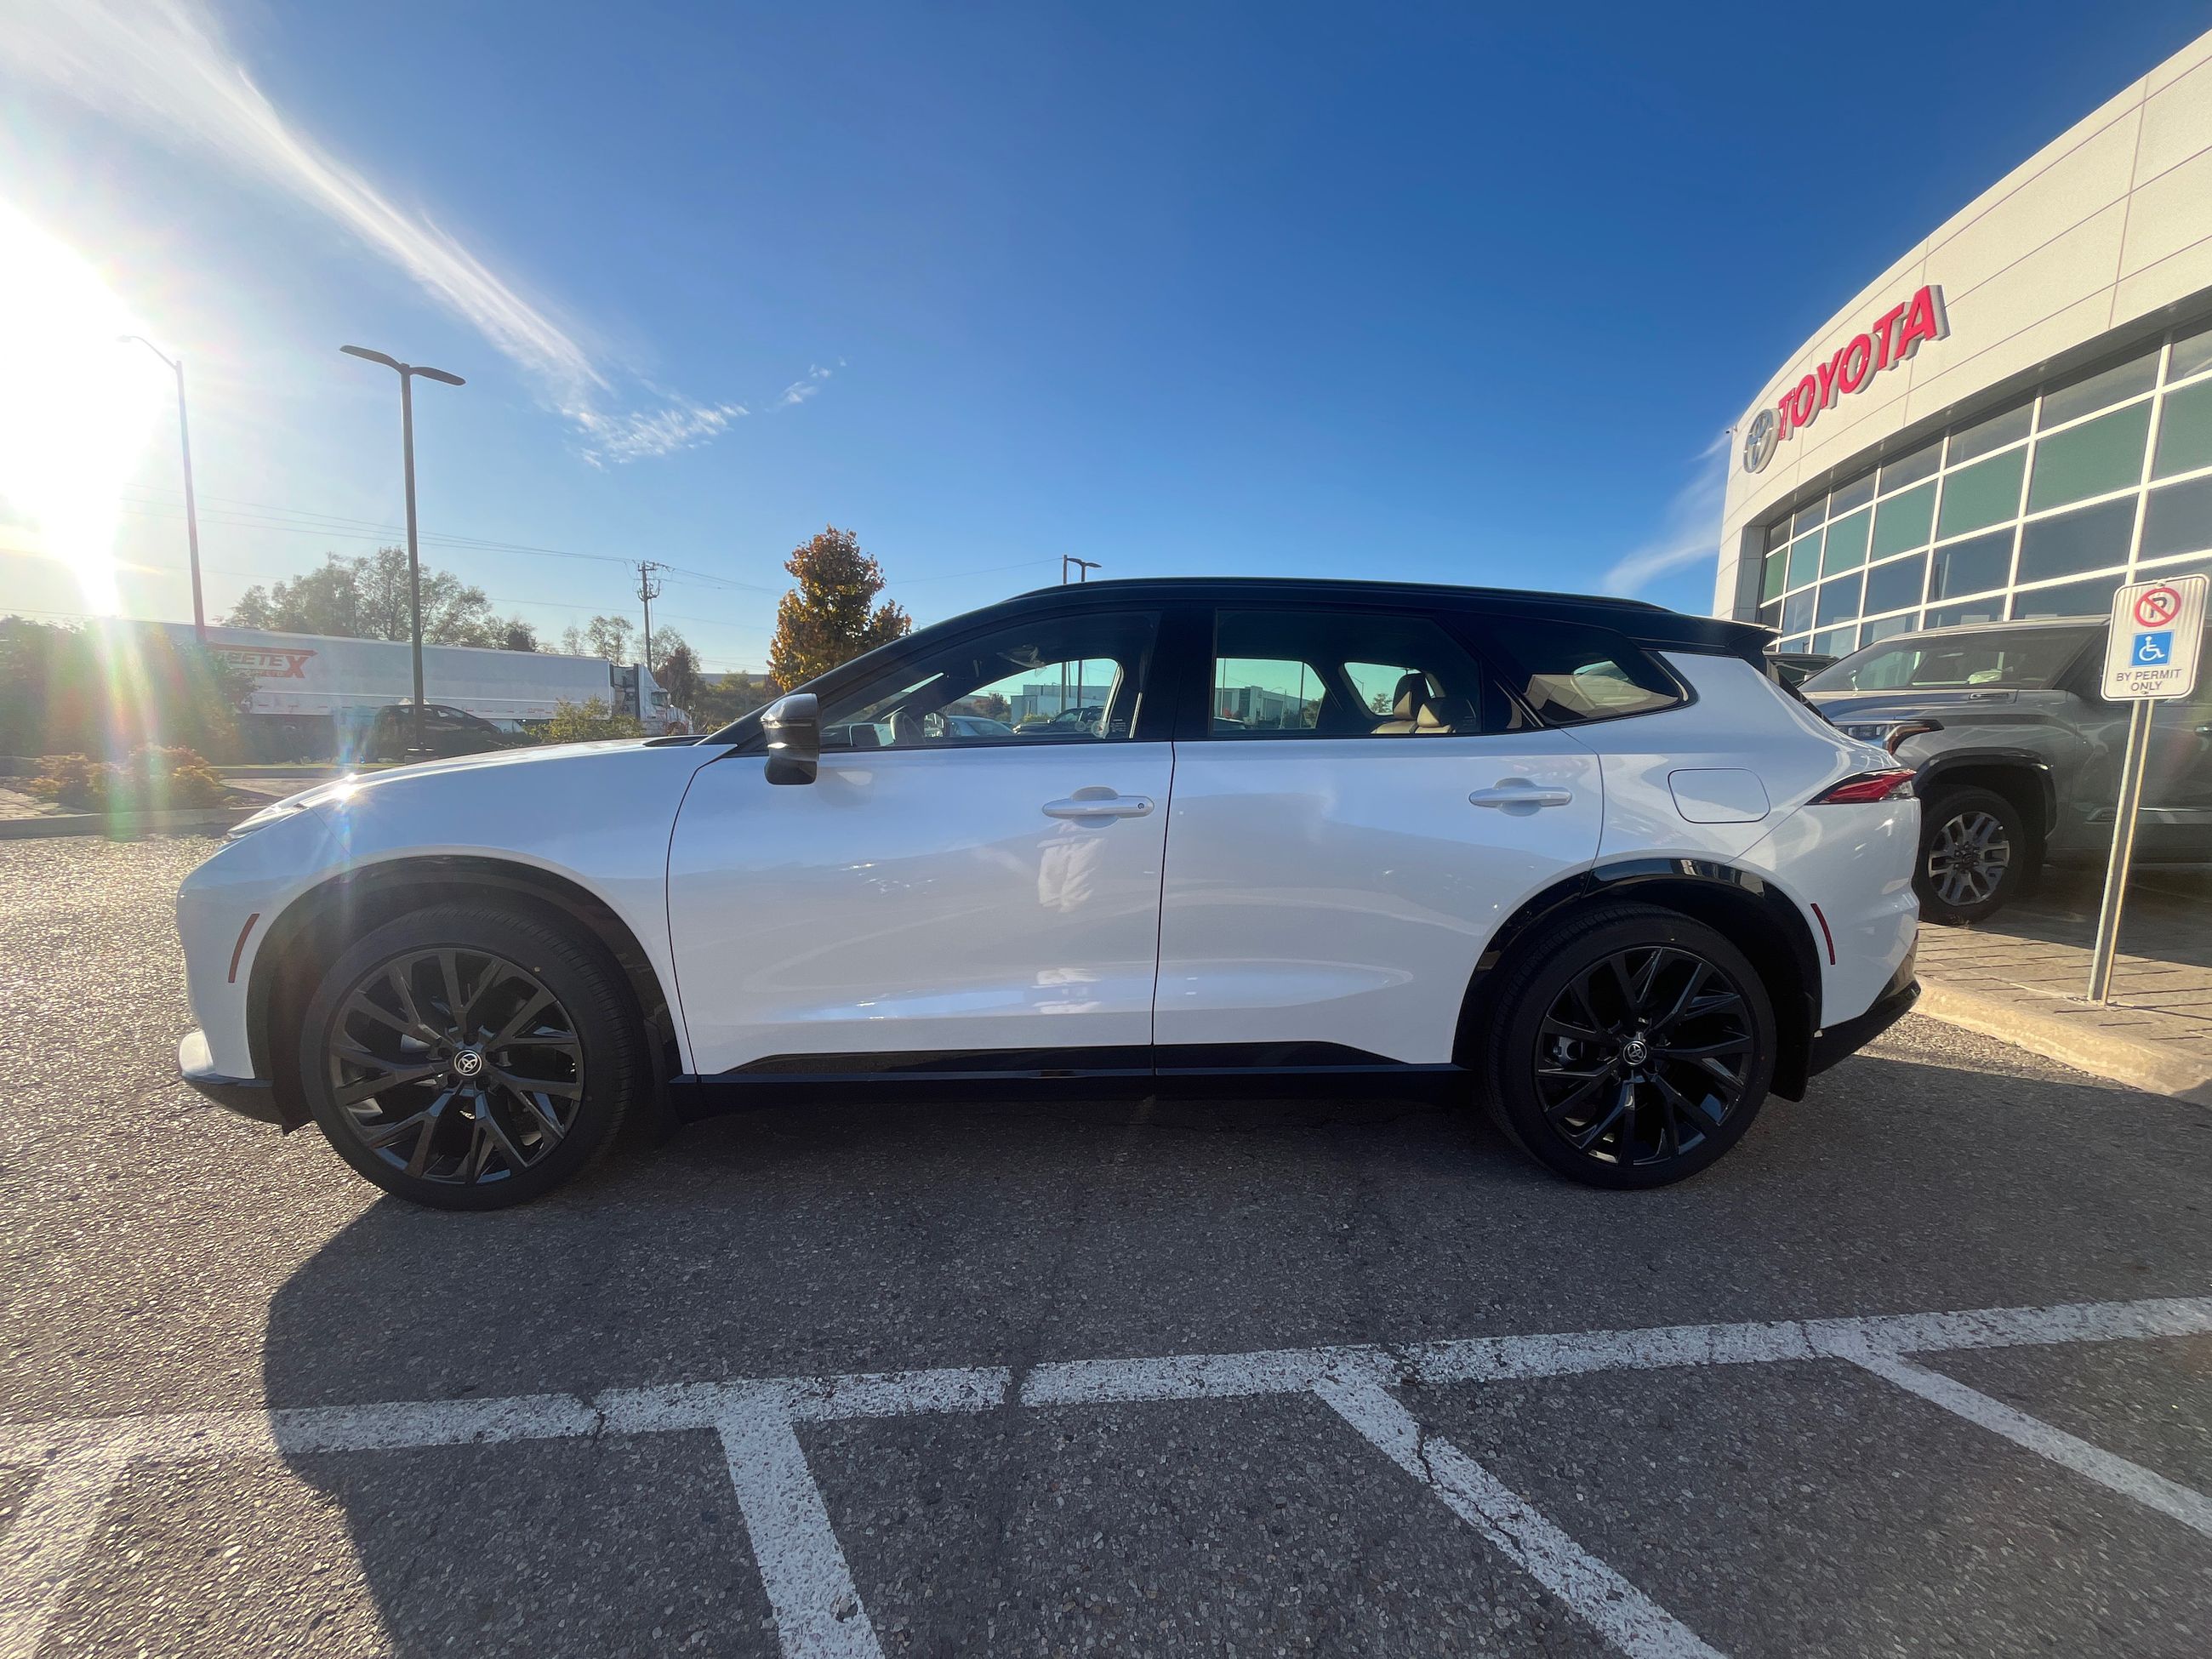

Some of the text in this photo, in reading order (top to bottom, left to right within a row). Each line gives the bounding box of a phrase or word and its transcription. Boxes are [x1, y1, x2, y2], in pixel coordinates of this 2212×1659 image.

[1778, 284, 1943, 441] TOYOTA
[2116, 669, 2182, 681] BY PERMIT
[2130, 681, 2163, 691] ONLY
